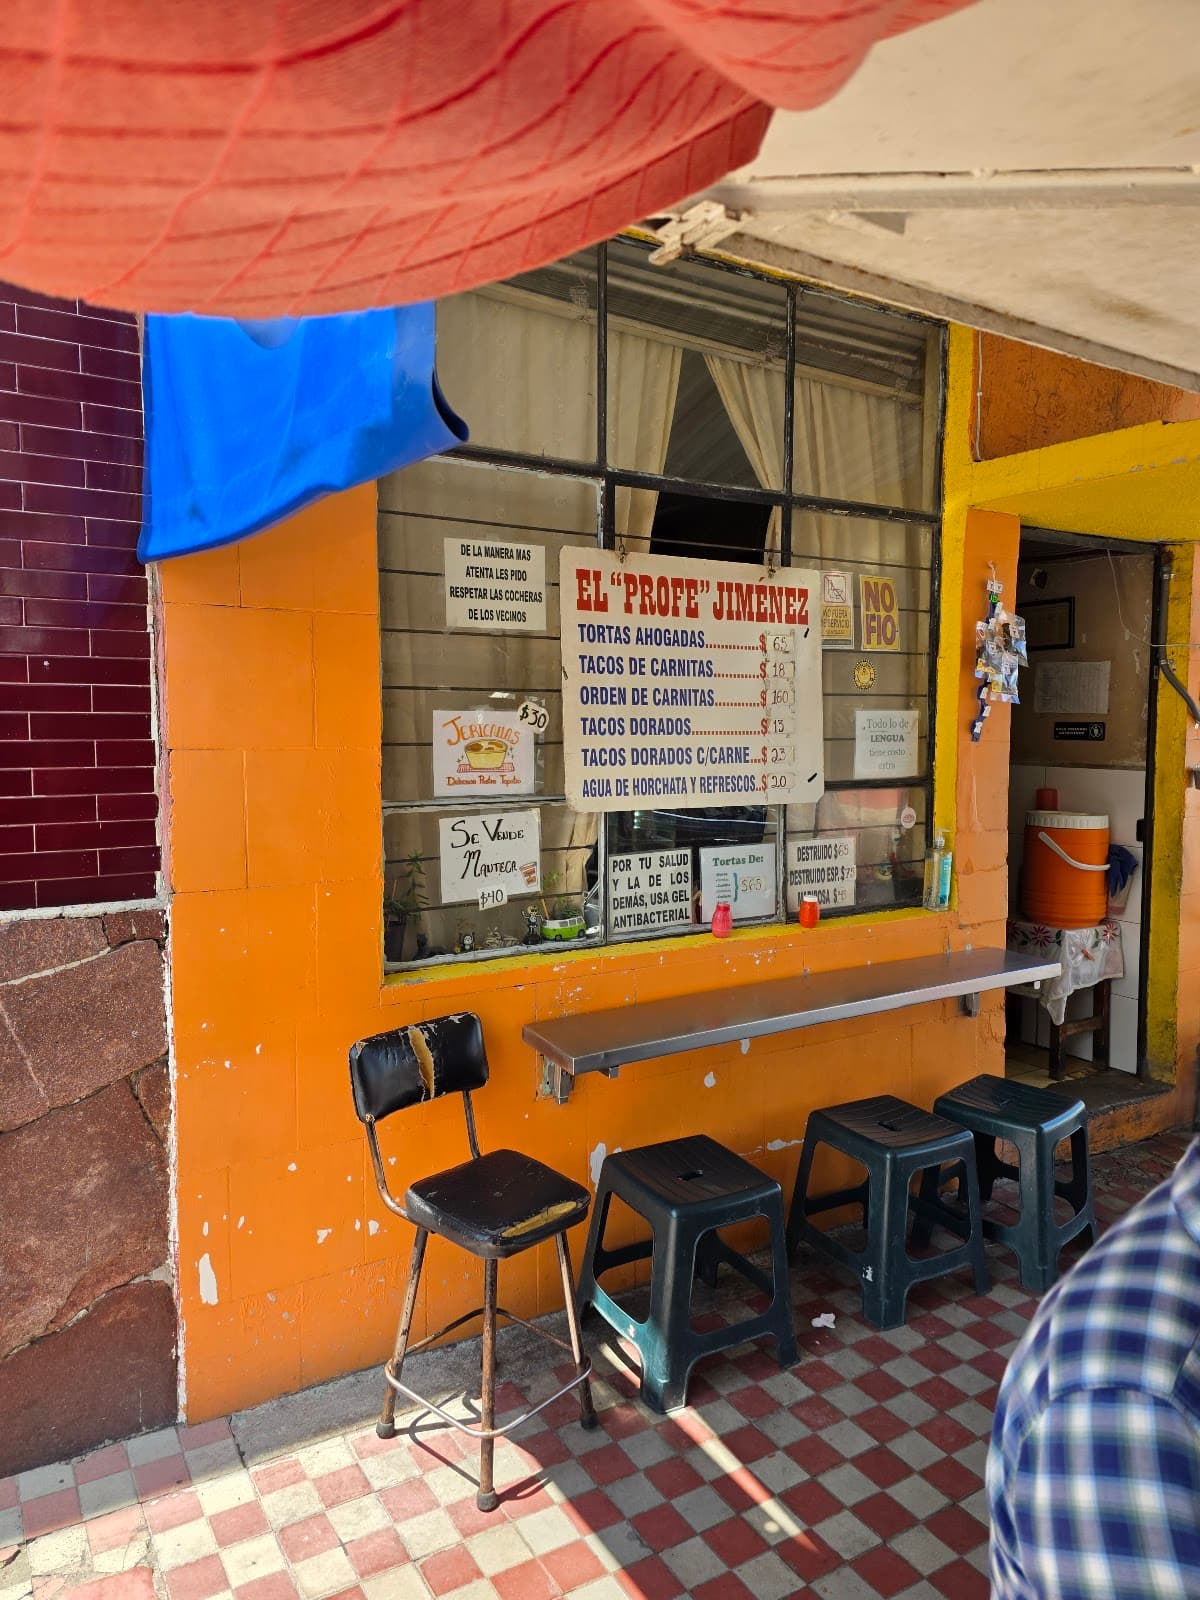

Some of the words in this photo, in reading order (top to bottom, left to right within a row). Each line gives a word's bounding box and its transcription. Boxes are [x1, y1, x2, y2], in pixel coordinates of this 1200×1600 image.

[461, 544, 471, 556] DE
[472, 544, 482, 557] LA
[484, 546, 514, 560] MANERA
[516, 548, 531, 561] MAS
[465, 566, 494, 579] ATENTA
[495, 568, 509, 580] LES
[510, 569, 527, 581] PIDO
[450, 585, 488, 599] RESPETAR
[489, 588, 503, 601] LAS
[504, 590, 543, 603] COCHERAS
[576, 568, 608, 613] EL
[712, 576, 809, 625] JIMÉNEZ
[864, 580, 895, 613] NO
[468, 608, 478, 620] DE
[480, 609, 494, 621] LOS
[495, 610, 527, 622] VECINOS
[578, 623, 631, 645] TORTAS
[865, 614, 896, 646] FIO
[578, 654, 624, 675] TACOS
[629, 656, 646, 675] DE
[580, 685, 627, 705] ORDEN
[631, 687, 648, 706] DE
[520, 704, 546, 729] $30
[580, 716, 625, 736] TACOS
[866, 718, 888, 729] Todo
[889, 717, 897, 729] lo
[899, 718, 909, 729] de
[870, 734, 905, 743] LENGUA
[581, 747, 627, 767] TACOS
[630, 747, 692, 766] DORADOS
[582, 778, 612, 798] AGUA
[615, 778, 629, 797] DE
[633, 776, 688, 796] HORCHATA
[689, 776, 697, 794] Y
[712, 856, 746, 867] Tortas
[748, 854, 764, 864] De:
[796, 843, 833, 862] DESTRUIDO
[612, 859, 632, 873] POR
[638, 856, 652, 870] TU
[658, 853, 689, 868] SALUD
[612, 878, 620, 891] Y
[627, 876, 641, 890] LA
[648, 874, 662, 887] DE
[670, 871, 689, 885] LOS
[789, 867, 826, 886] DESTRUIDO
[826, 866, 840, 882] ESP.
[480, 889, 504, 909] $40
[612, 891, 648, 910] DEMÁS,
[650, 891, 669, 906] USA
[671, 889, 690, 903] GEL
[613, 907, 690, 929] ANTIBACTERIAL
